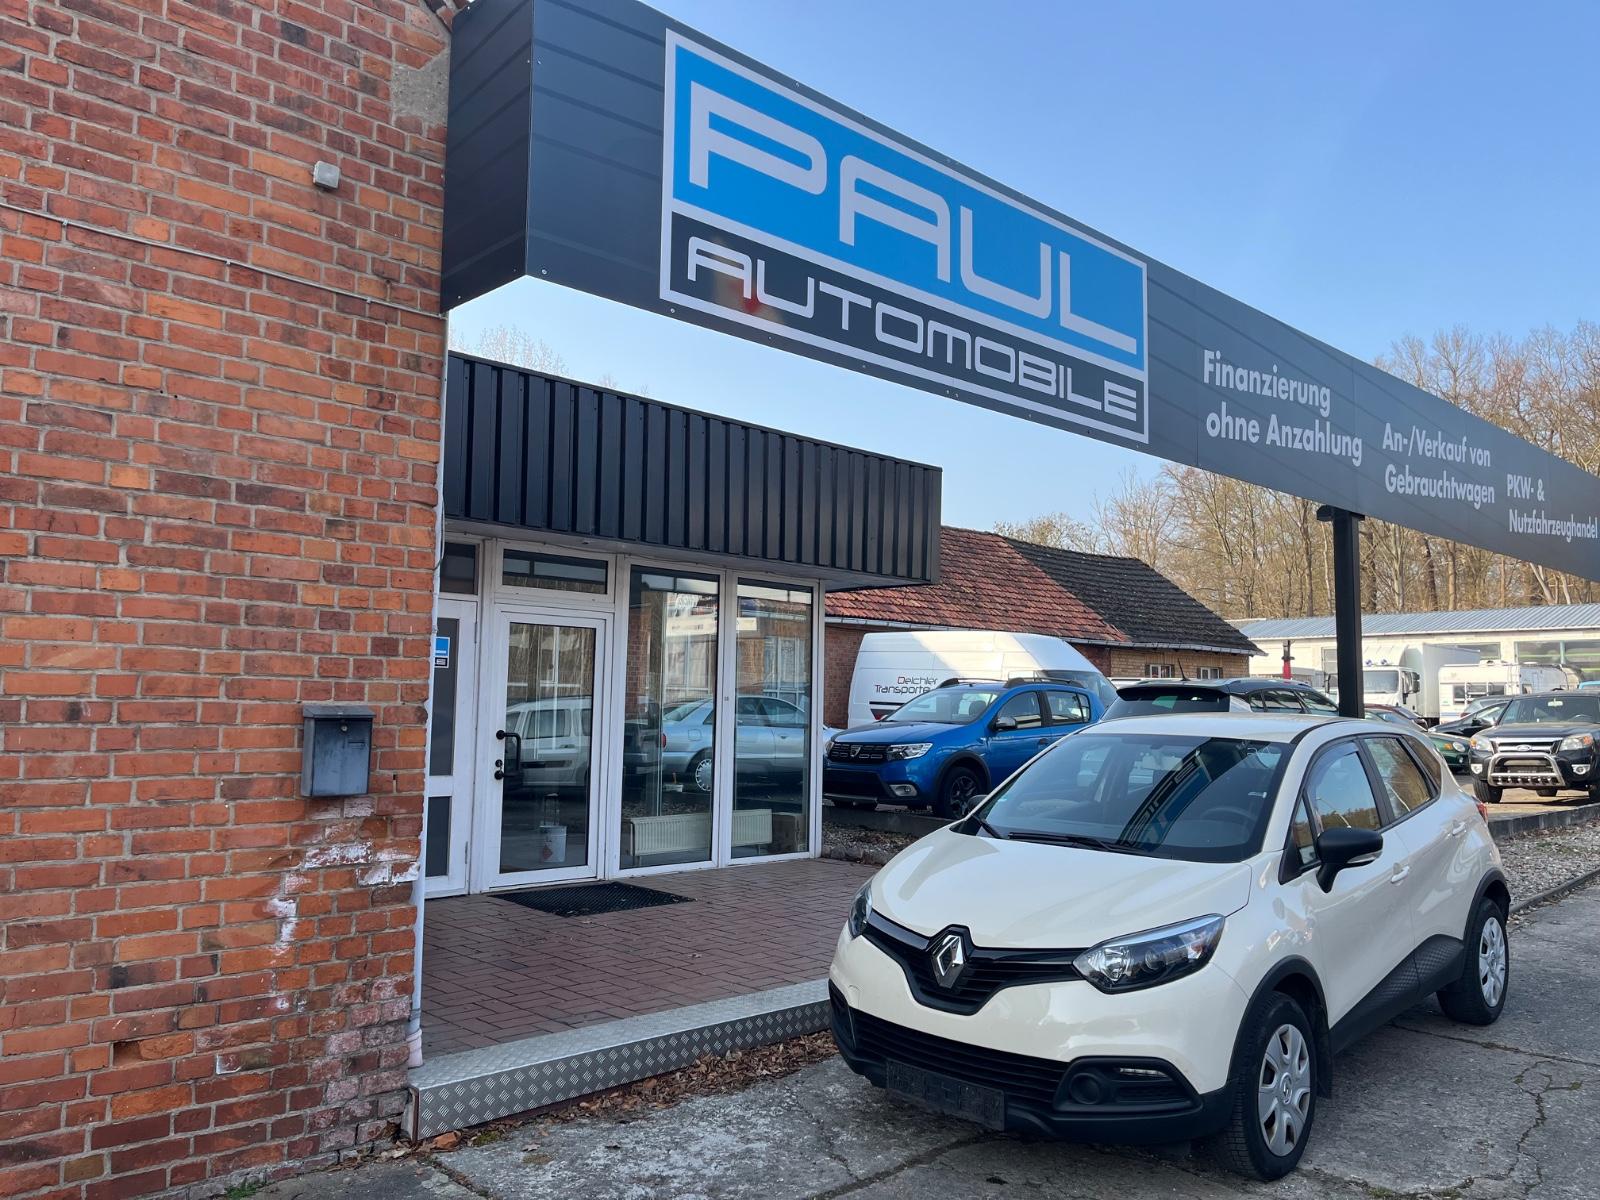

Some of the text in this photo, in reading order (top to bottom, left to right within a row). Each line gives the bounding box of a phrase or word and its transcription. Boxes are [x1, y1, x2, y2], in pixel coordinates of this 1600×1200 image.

[689, 80, 1137, 355] PAUL
[687, 236, 1137, 421] AUTOMOBILE
[1203, 349, 1331, 418] Finanzierung
[1206, 401, 1362, 467] ohne Anzahlung
[1382, 422, 1491, 467] An-/Verkauf von
[1385, 464, 1495, 510] Gebrauchtwagen
[1507, 474, 1545, 501] PKW- &
[1509, 509, 1598, 543] Nutzfahrzeughandel
